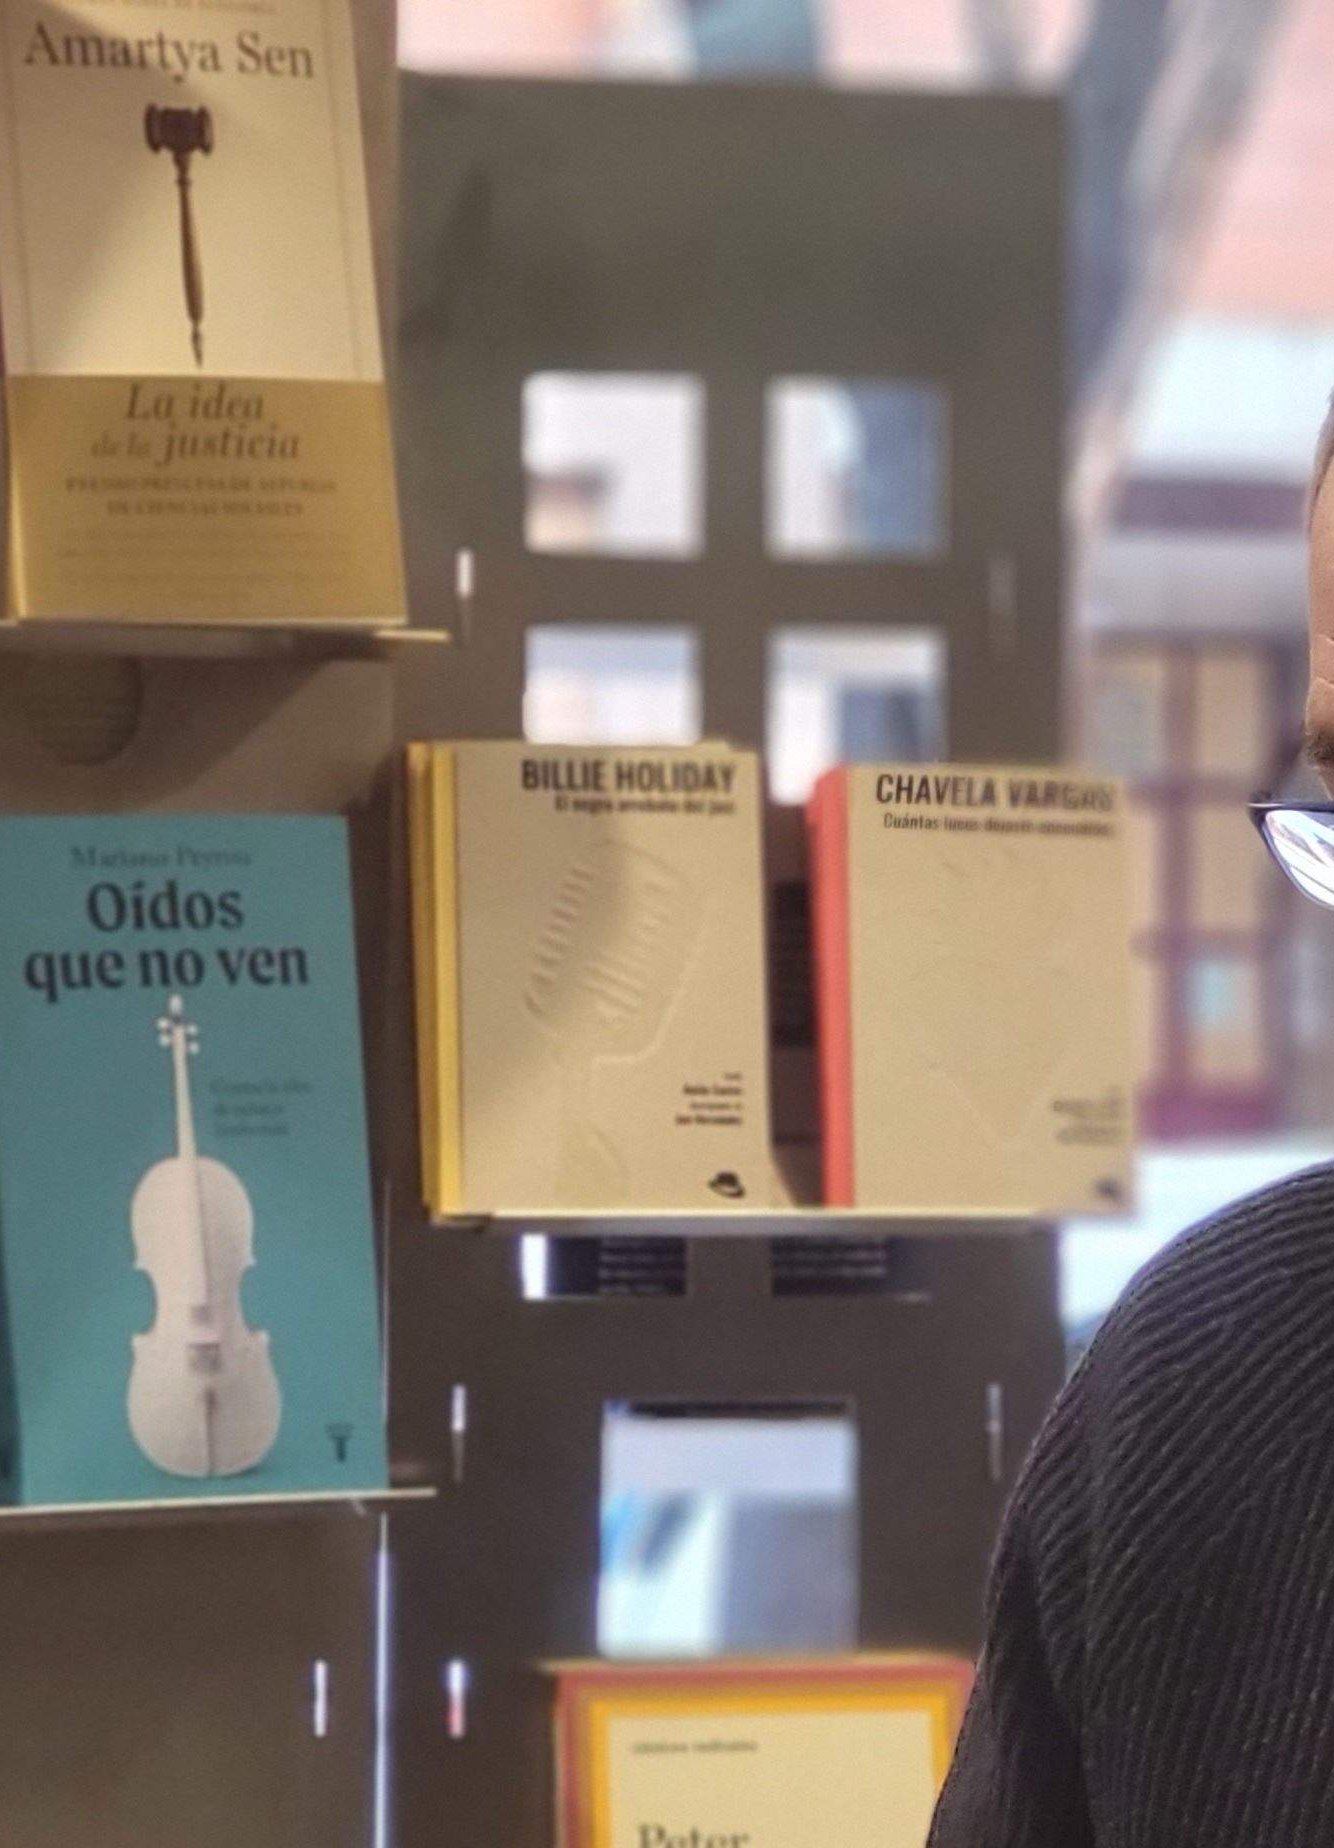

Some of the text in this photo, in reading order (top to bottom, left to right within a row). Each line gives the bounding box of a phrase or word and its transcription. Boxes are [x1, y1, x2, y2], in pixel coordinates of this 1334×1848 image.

[25, 21, 315, 84] Amartya Sen
[126, 381, 264, 420] La idea
[153, 421, 301, 468] justicia
[522, 758, 736, 793] BILLIE HOLIDAY
[874, 773, 1115, 812] CHAVELA VARGAS
[883, 811, 940, 830] Cuántas
[86, 879, 245, 932] Oídos
[24, 947, 310, 1003] que no ven
